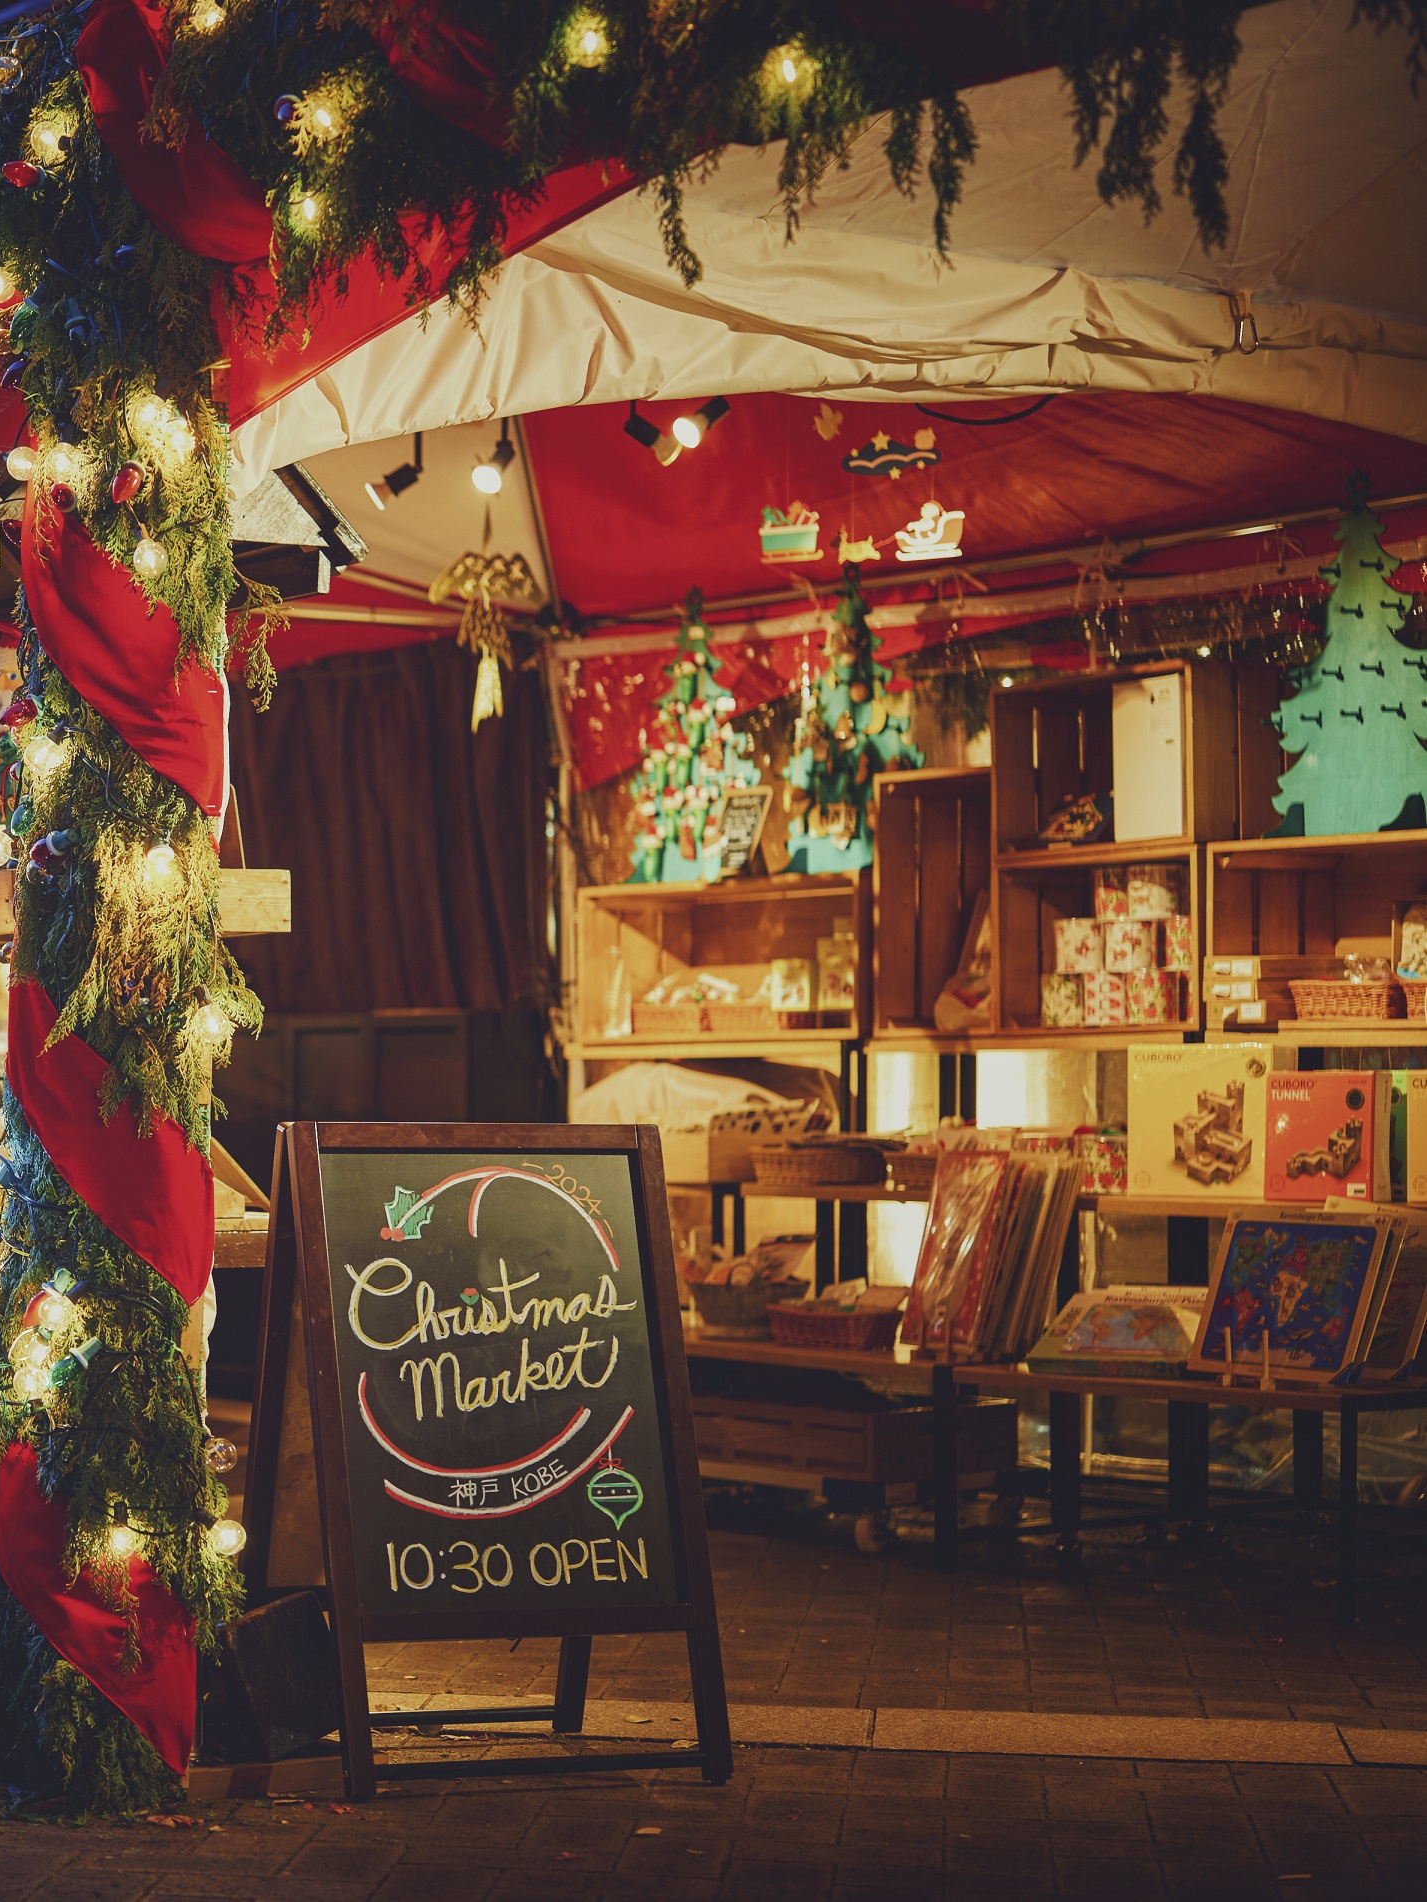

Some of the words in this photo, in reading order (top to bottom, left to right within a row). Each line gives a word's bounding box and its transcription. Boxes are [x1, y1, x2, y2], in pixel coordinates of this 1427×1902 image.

[1134, 1051, 1182, 1063] CUBORO
[1270, 1078, 1315, 1090] CUBORO
[1271, 1089, 1311, 1101] TUNNEL
[344, 1258, 637, 1350] Christmas
[400, 1327, 619, 1421] Market
[448, 1479, 500, 1507] 神戸
[512, 1459, 569, 1500] KOBE
[386, 1541, 513, 1593] 10:30
[530, 1537, 648, 1586] OPEN
